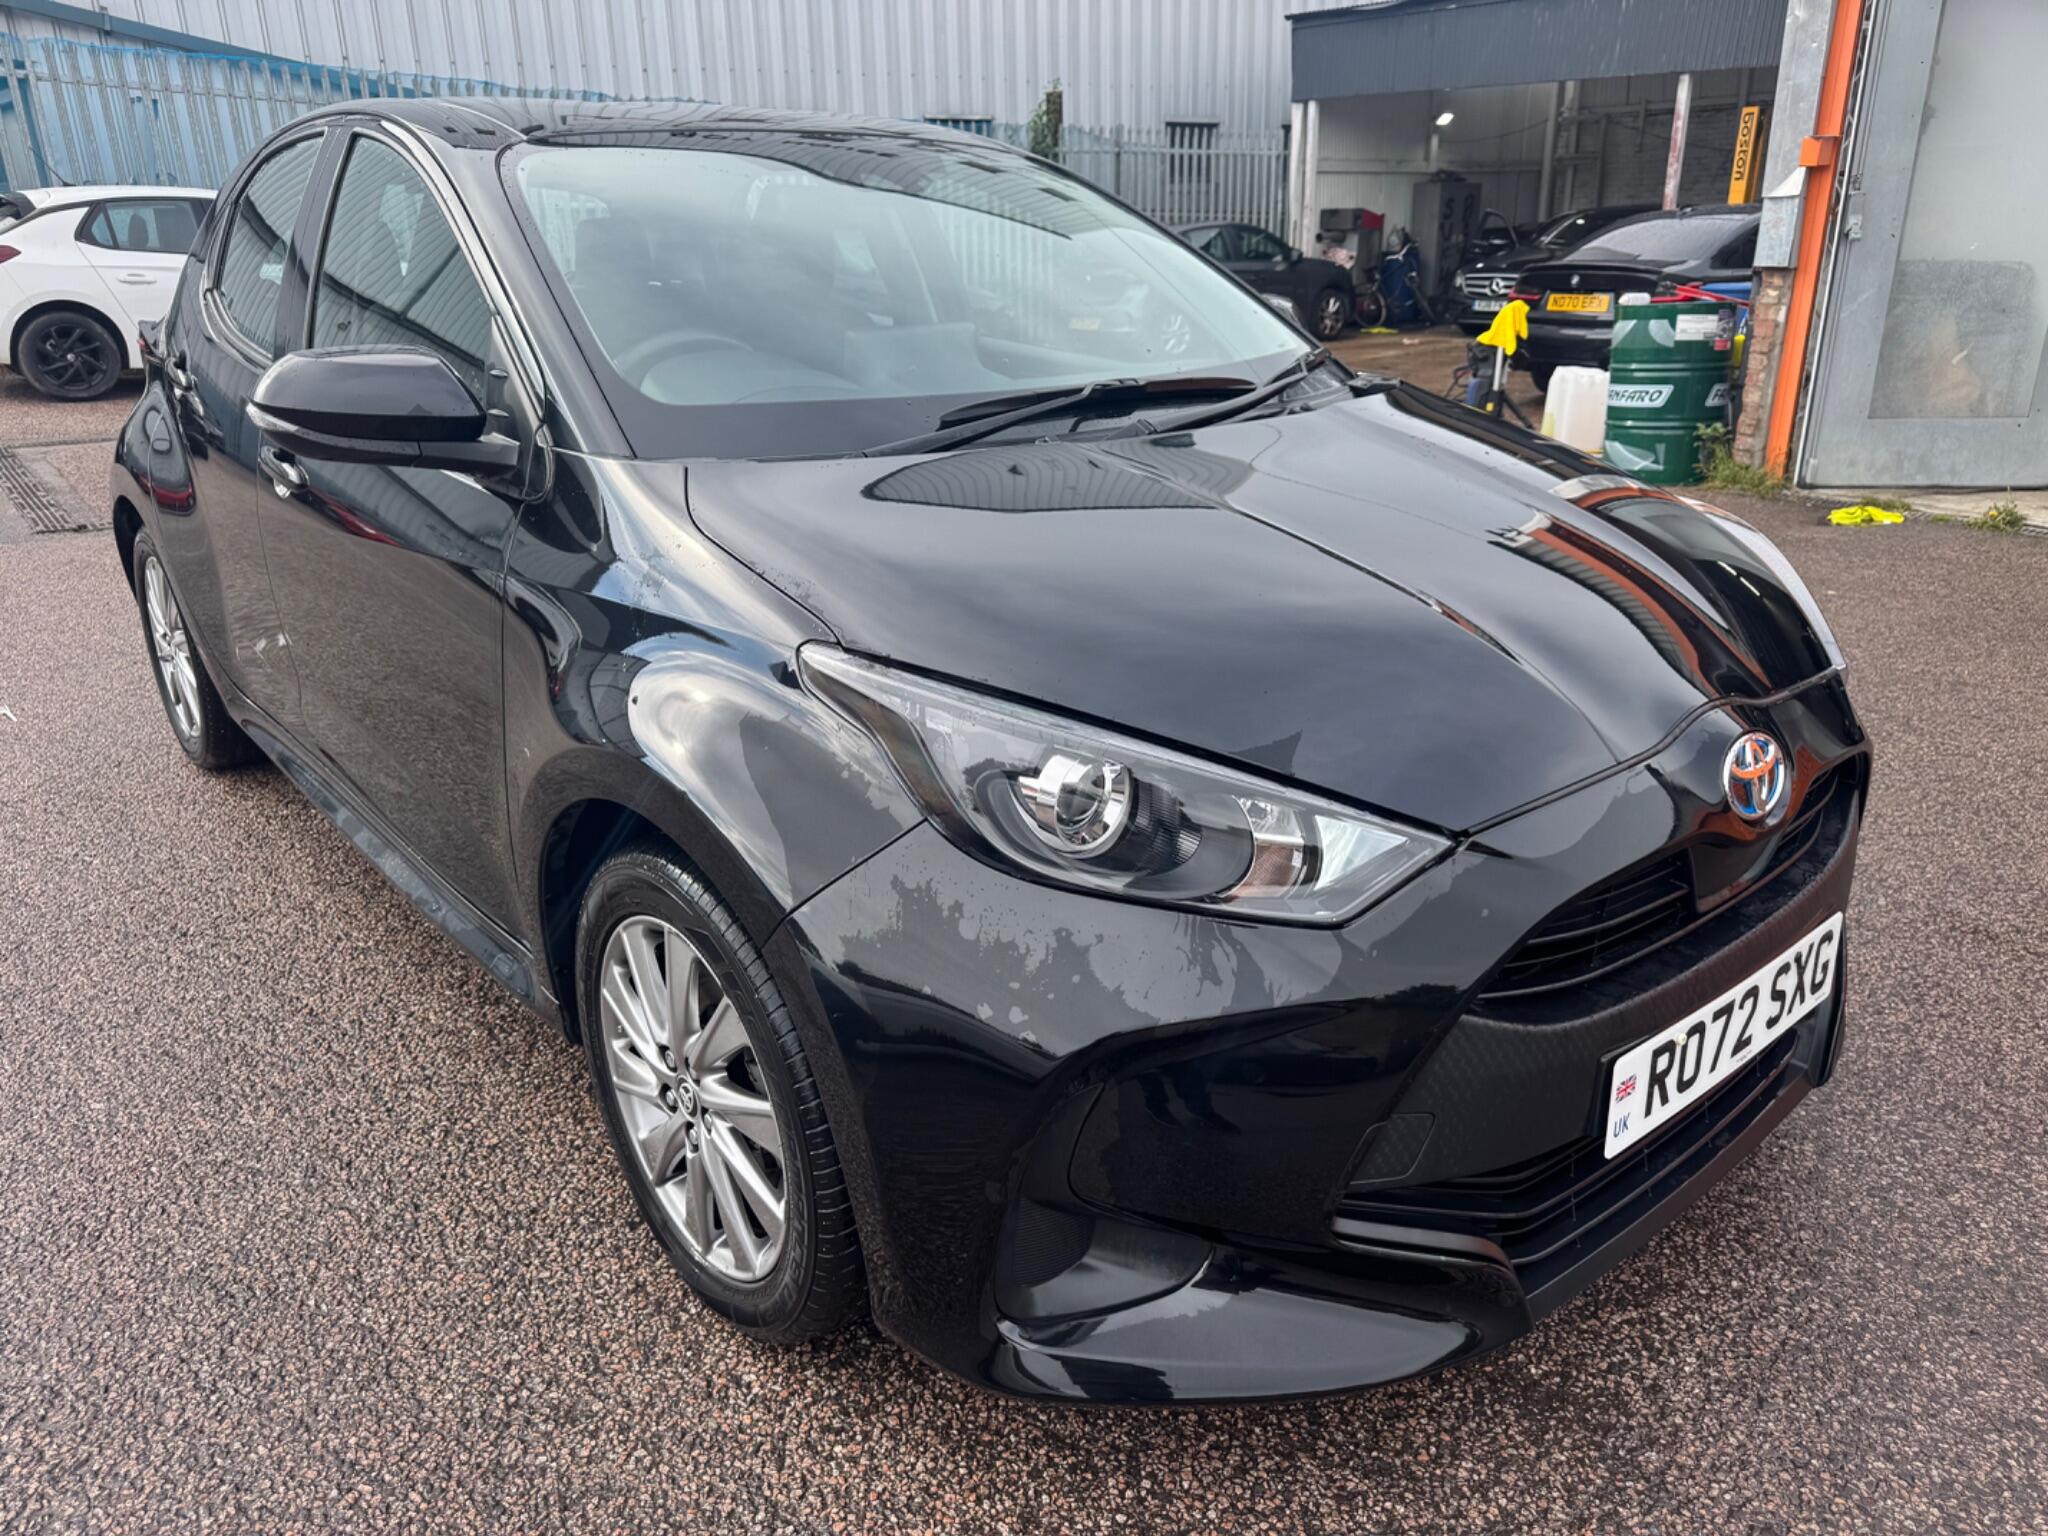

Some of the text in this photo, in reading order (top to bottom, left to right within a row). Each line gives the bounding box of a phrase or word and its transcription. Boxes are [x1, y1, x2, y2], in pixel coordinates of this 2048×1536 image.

[1608, 389, 1663, 402] ANFARO
[1645, 929, 1834, 1119] RO72 SXG
[1613, 1112, 1630, 1138] UK
